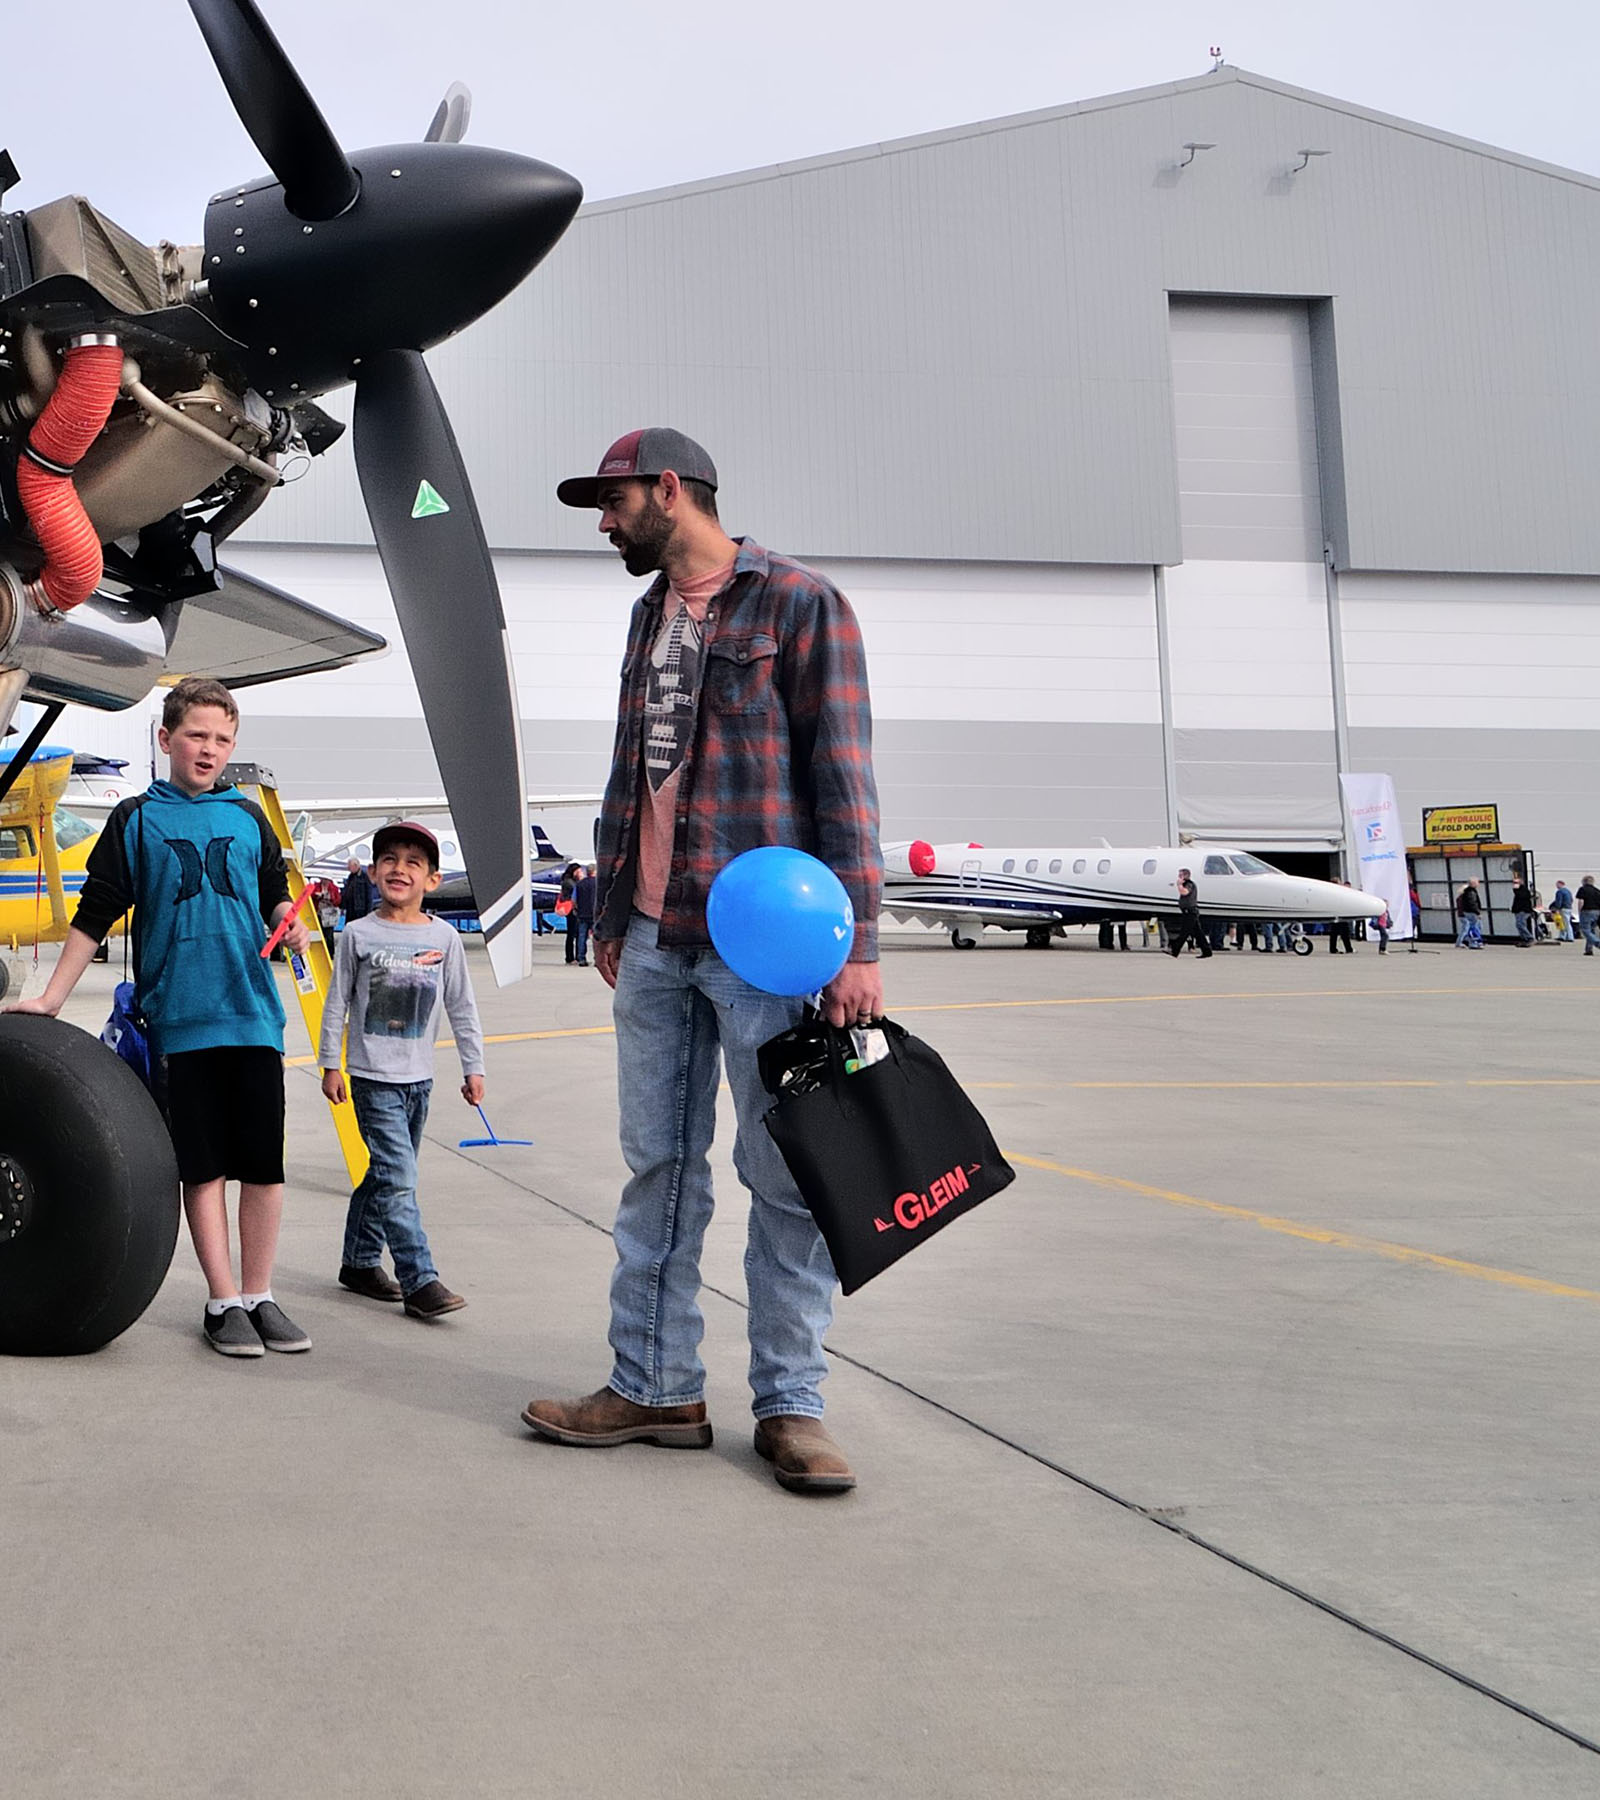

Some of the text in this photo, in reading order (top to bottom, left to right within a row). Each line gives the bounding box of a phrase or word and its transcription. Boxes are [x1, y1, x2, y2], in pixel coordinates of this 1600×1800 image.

[1446, 814, 1492, 823] HYDRAULIC
[1464, 823, 1492, 831] DOORS
[372, 950, 439, 972] Advenre
